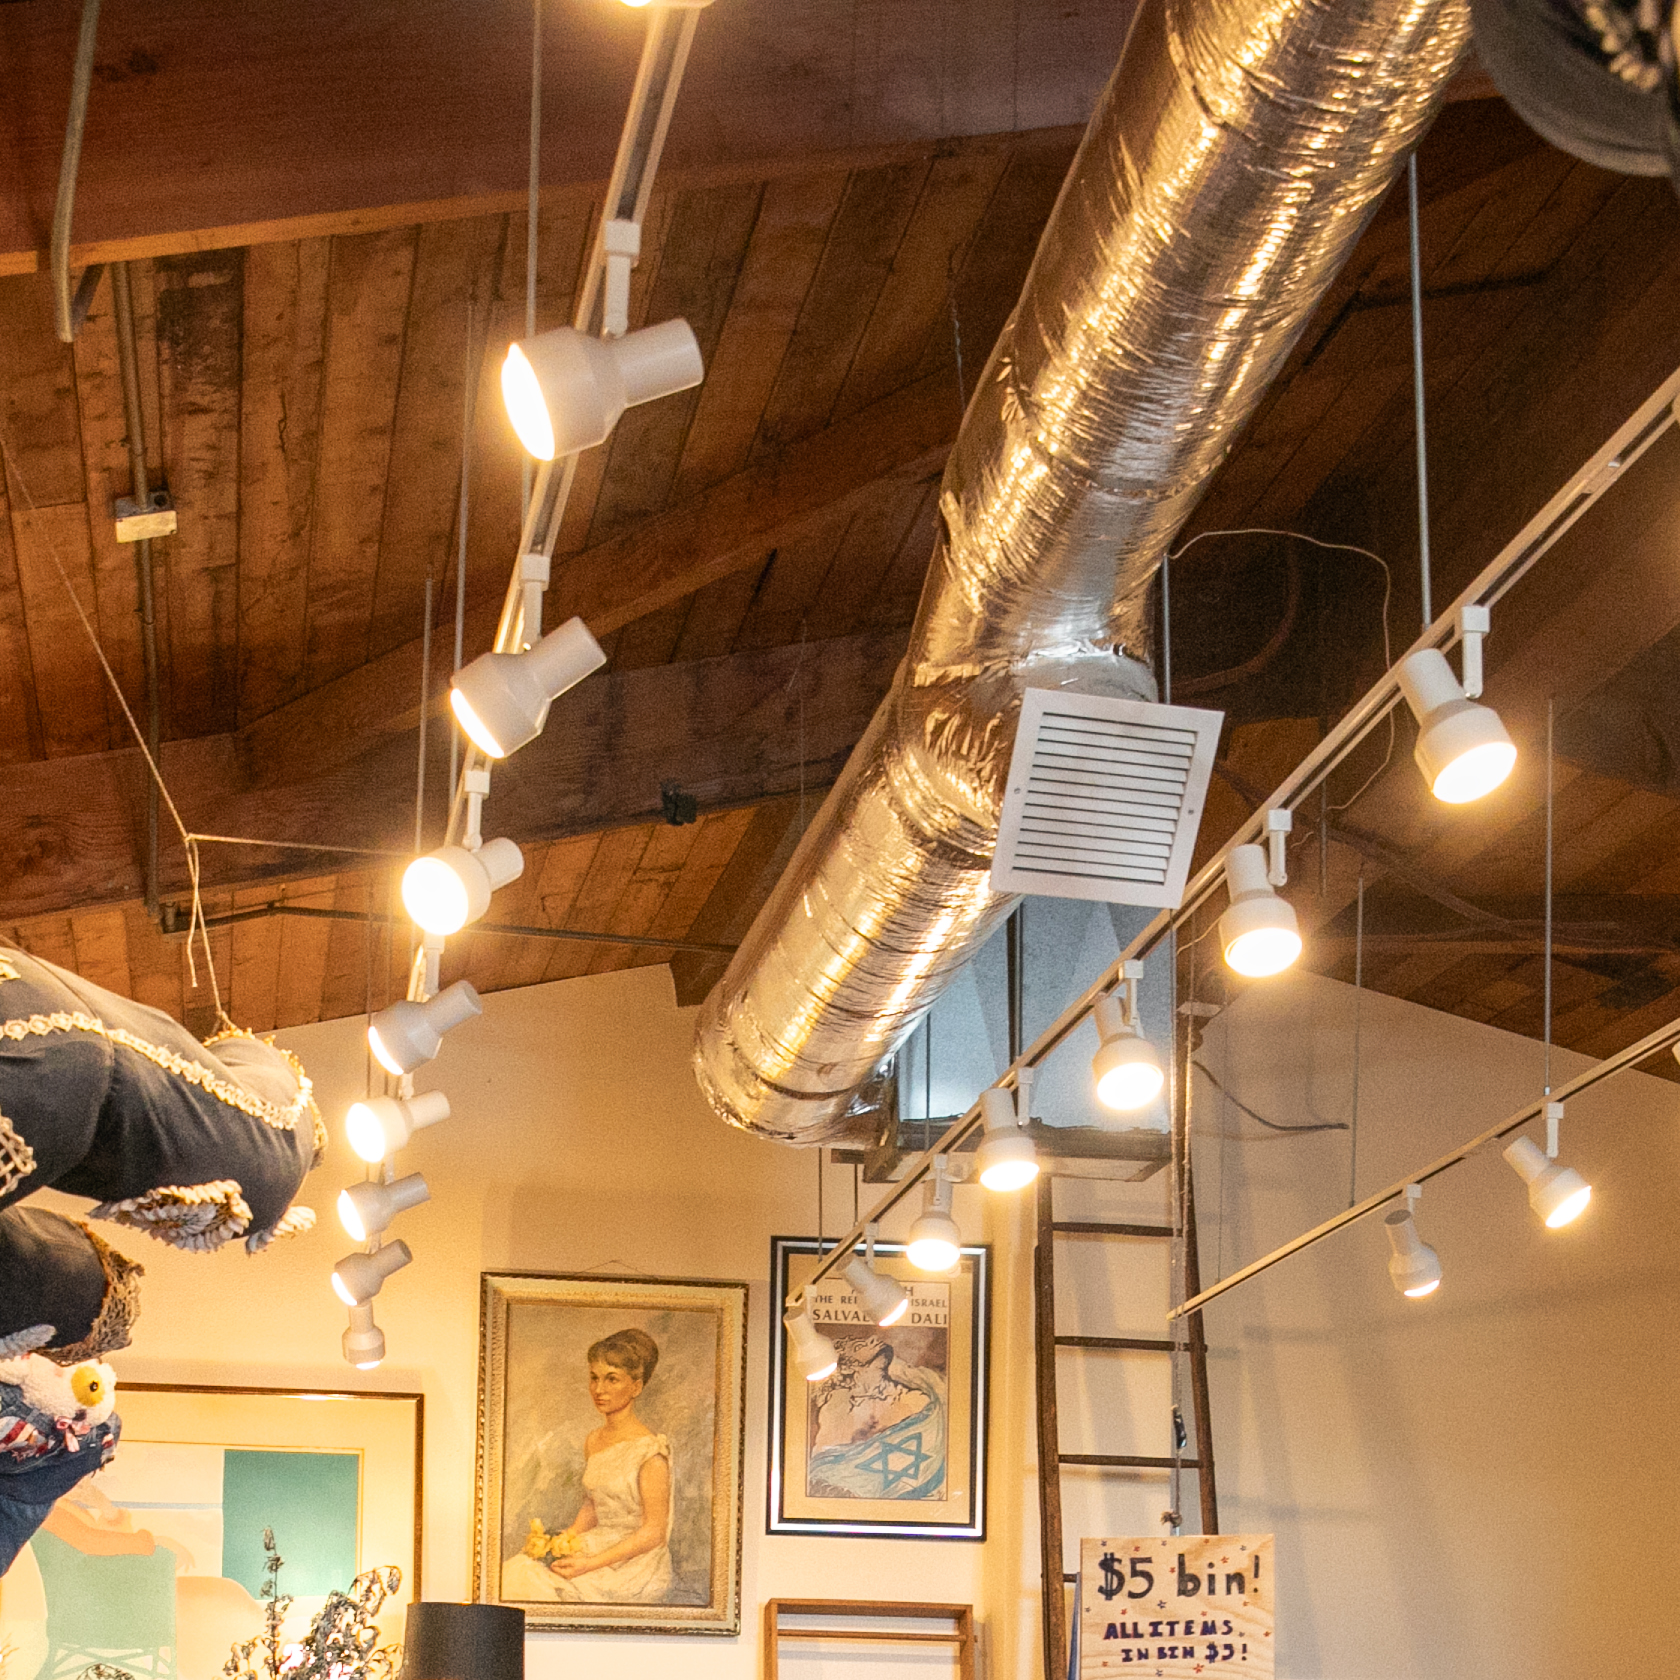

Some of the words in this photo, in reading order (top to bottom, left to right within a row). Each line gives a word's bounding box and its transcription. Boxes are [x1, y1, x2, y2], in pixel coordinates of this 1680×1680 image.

[911, 1298, 947, 1308] ISRAEL
[812, 1308, 871, 1322] SALVA
[911, 1312, 947, 1325] DALI
[1097, 1552, 1155, 1601] $5
[1176, 1553, 1260, 1597] bin!
[1103, 1621, 1144, 1640] ALL
[1148, 1619, 1234, 1638] ITEMS
[1121, 1648, 1150, 1663] IN
[1156, 1645, 1196, 1660] BIN
